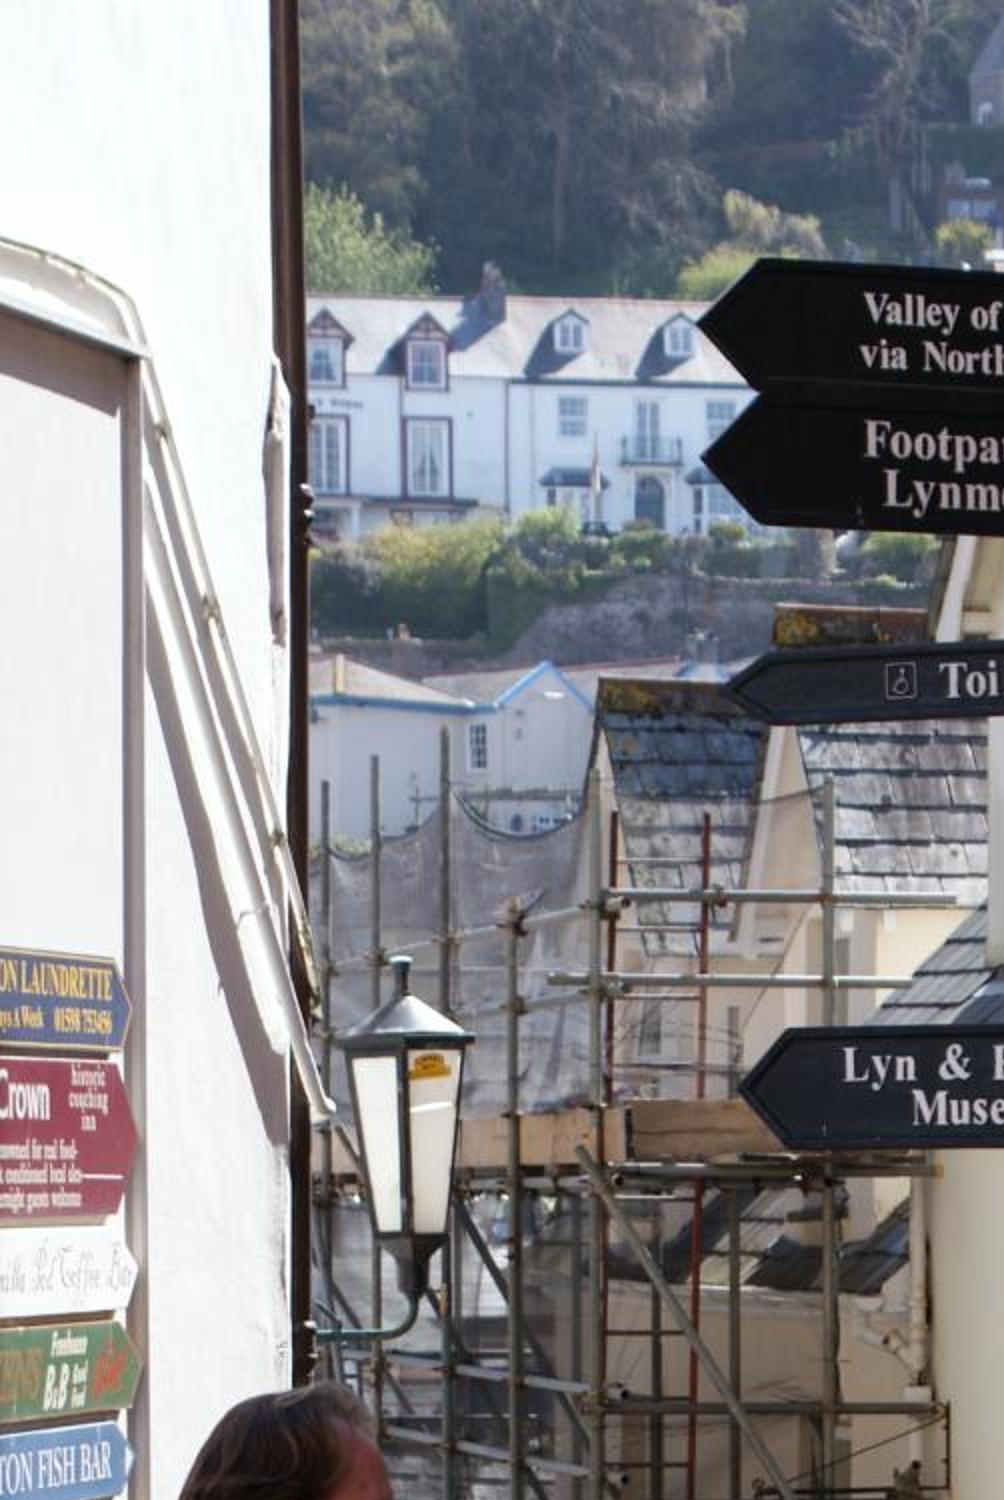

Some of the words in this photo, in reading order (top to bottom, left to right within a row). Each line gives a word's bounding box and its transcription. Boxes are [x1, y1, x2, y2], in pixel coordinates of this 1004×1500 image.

[864, 292, 960, 335] Valley
[970, 301, 1003, 331] of
[860, 339, 908, 370] via
[21, 960, 112, 1001] LAUNDRETTE
[71, 1063, 106, 1088] historic
[842, 1047, 918, 1091] Lyn
[938, 1043, 972, 1082] &
[69, 1087, 109, 1116] coaching
[80, 1108, 97, 1132] inn
[37, 1445, 75, 1489] FISH
[80, 1441, 112, 1483] BAR
